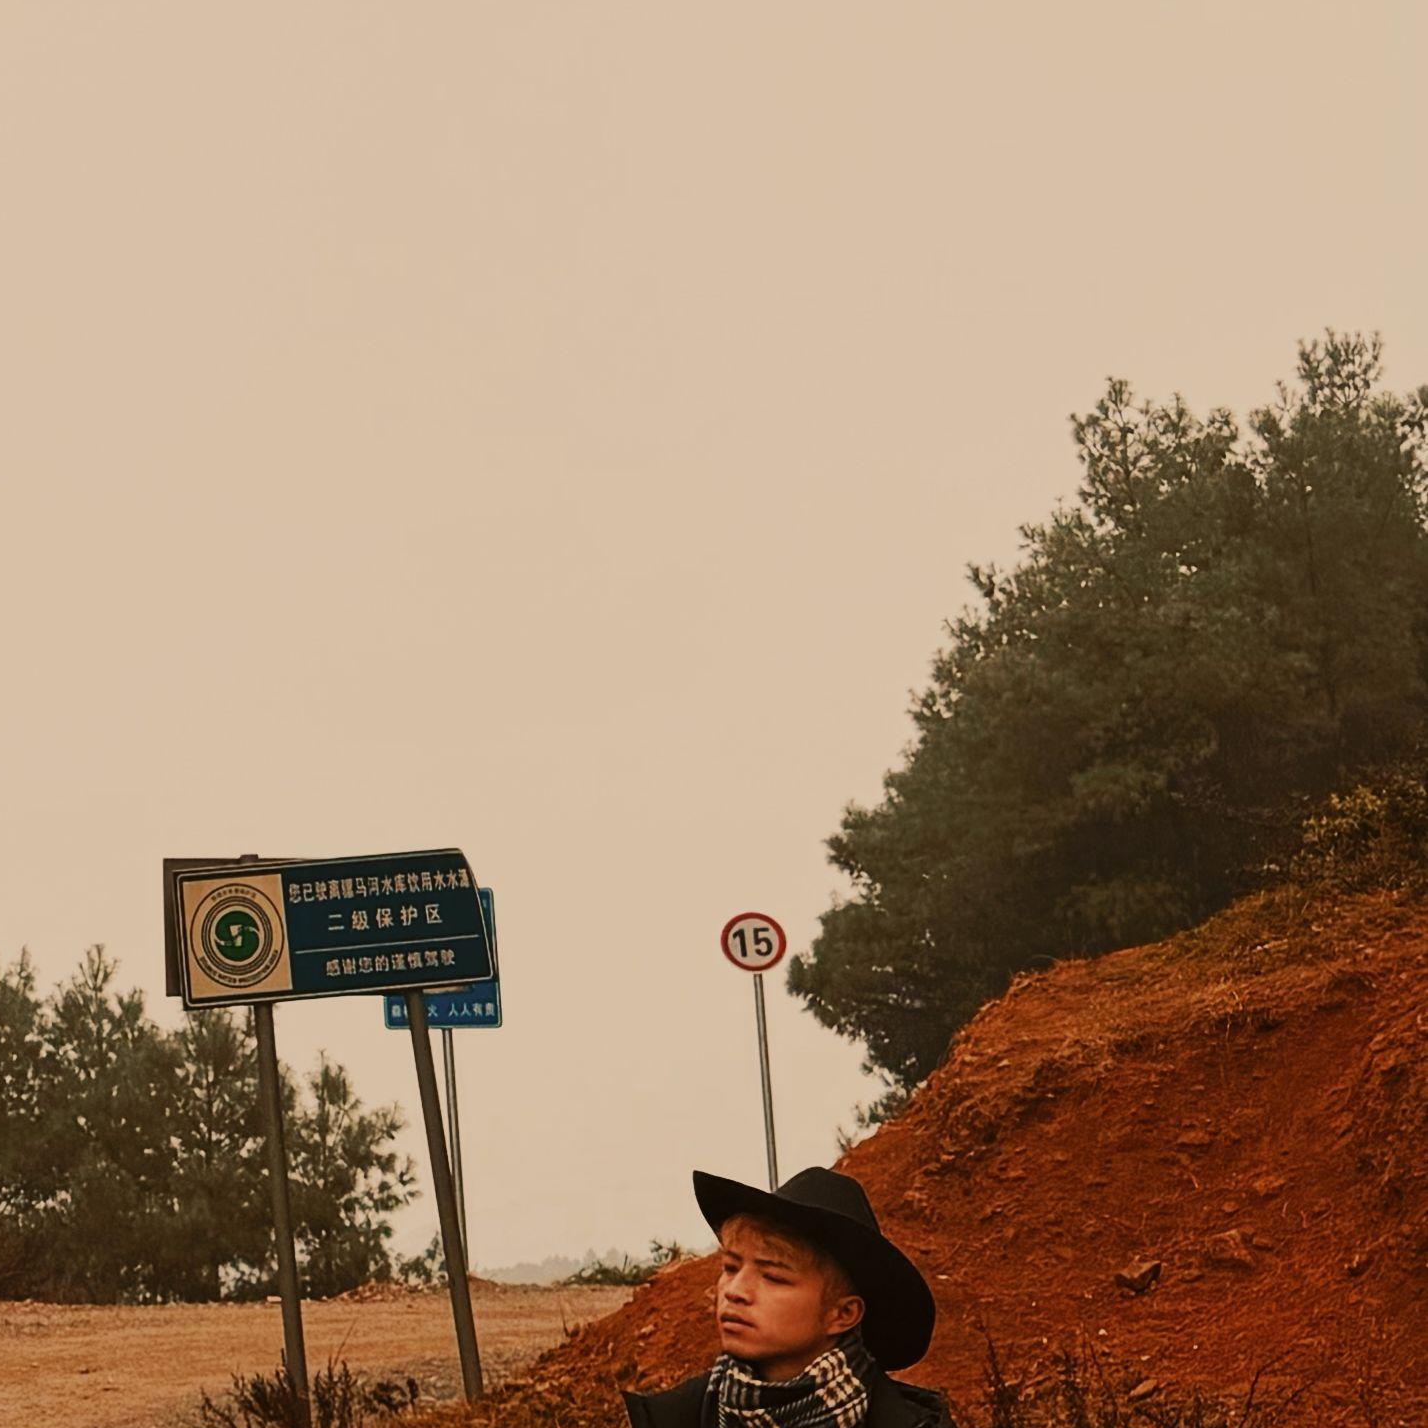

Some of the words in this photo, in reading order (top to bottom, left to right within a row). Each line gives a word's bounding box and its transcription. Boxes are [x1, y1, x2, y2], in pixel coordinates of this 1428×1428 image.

[328, 903, 443, 932] 二级保护区
[732, 927, 773, 957] 15
[325, 948, 456, 977] 感谢您的谨慎驾驶
